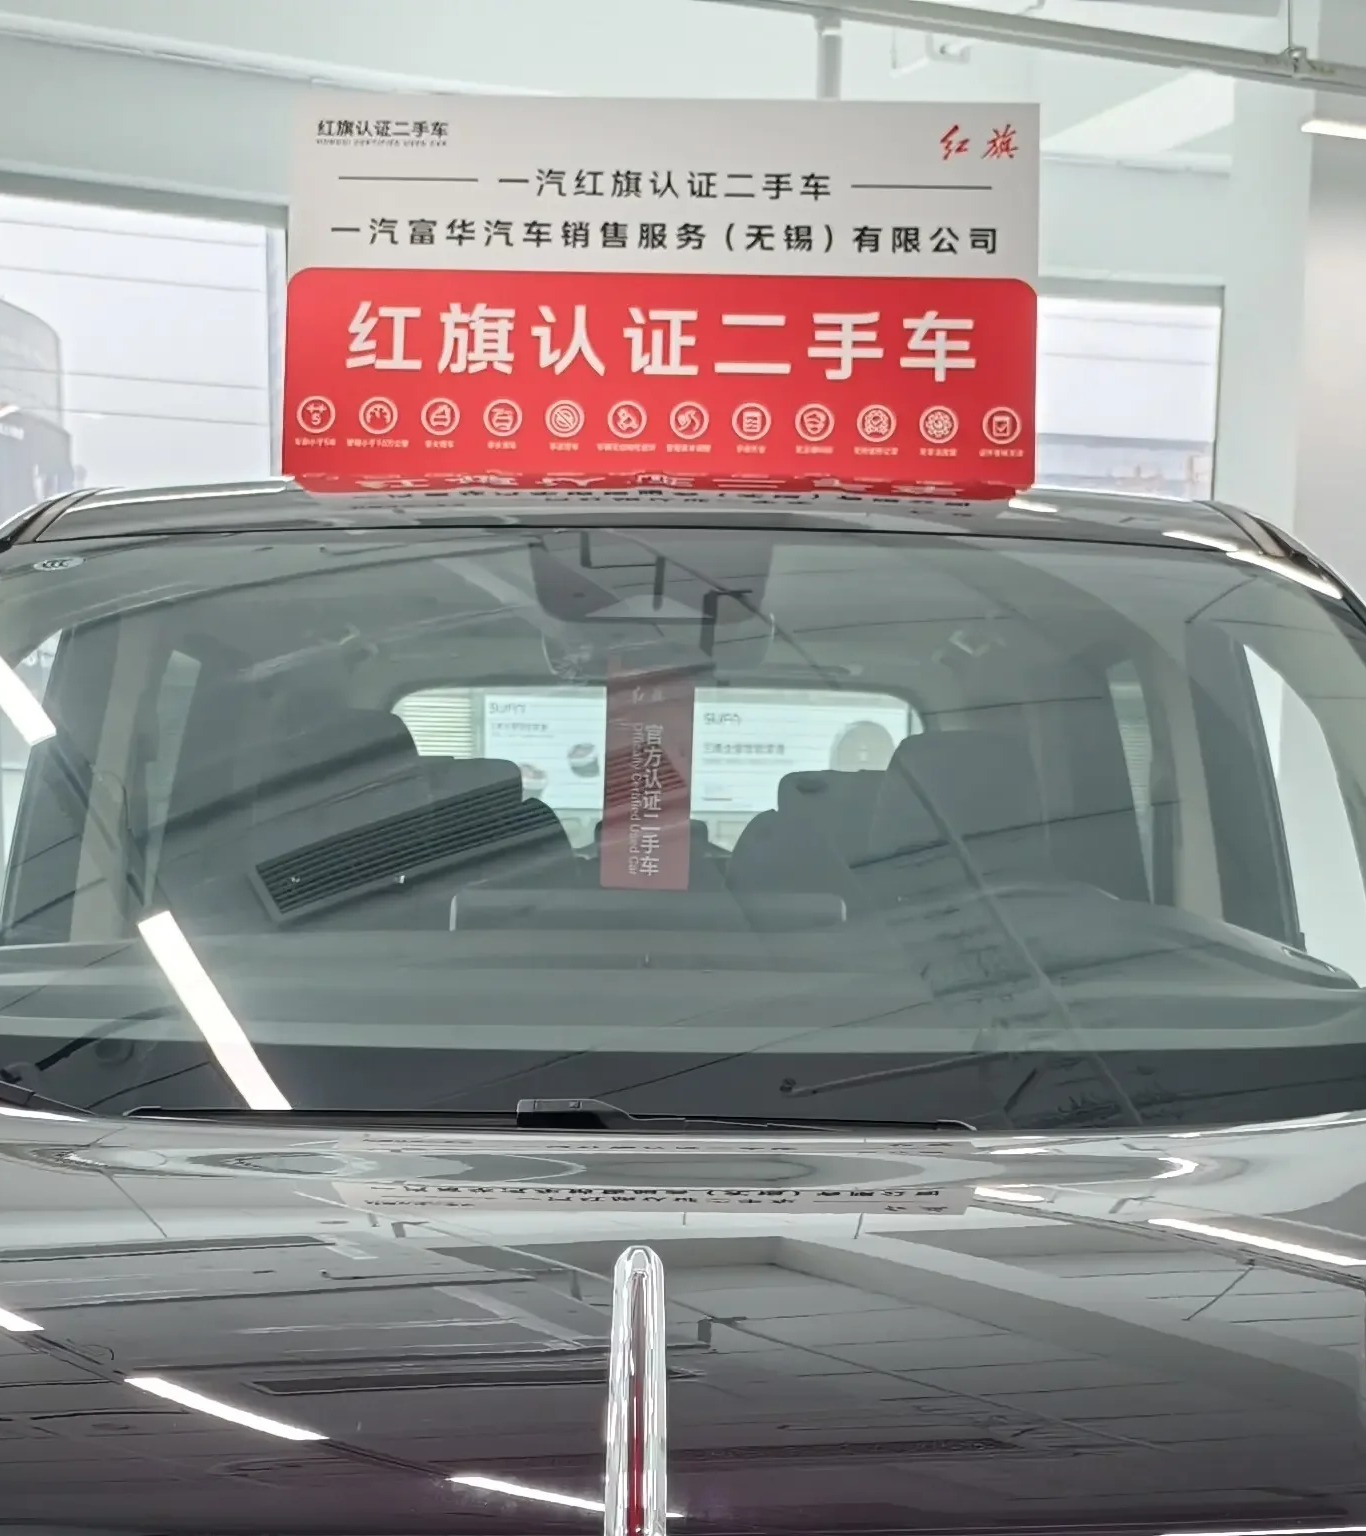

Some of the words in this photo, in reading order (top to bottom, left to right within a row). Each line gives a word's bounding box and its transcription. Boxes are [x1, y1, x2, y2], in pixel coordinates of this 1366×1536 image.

[317, 119, 449, 138] 红旗认证二手车
[939, 123, 1019, 160] 红旗
[498, 168, 831, 201] 一汽红旗认证二手车
[346, 301, 978, 382] 红旗认证二手车
[639, 724, 664, 877] 官方认证二手车
